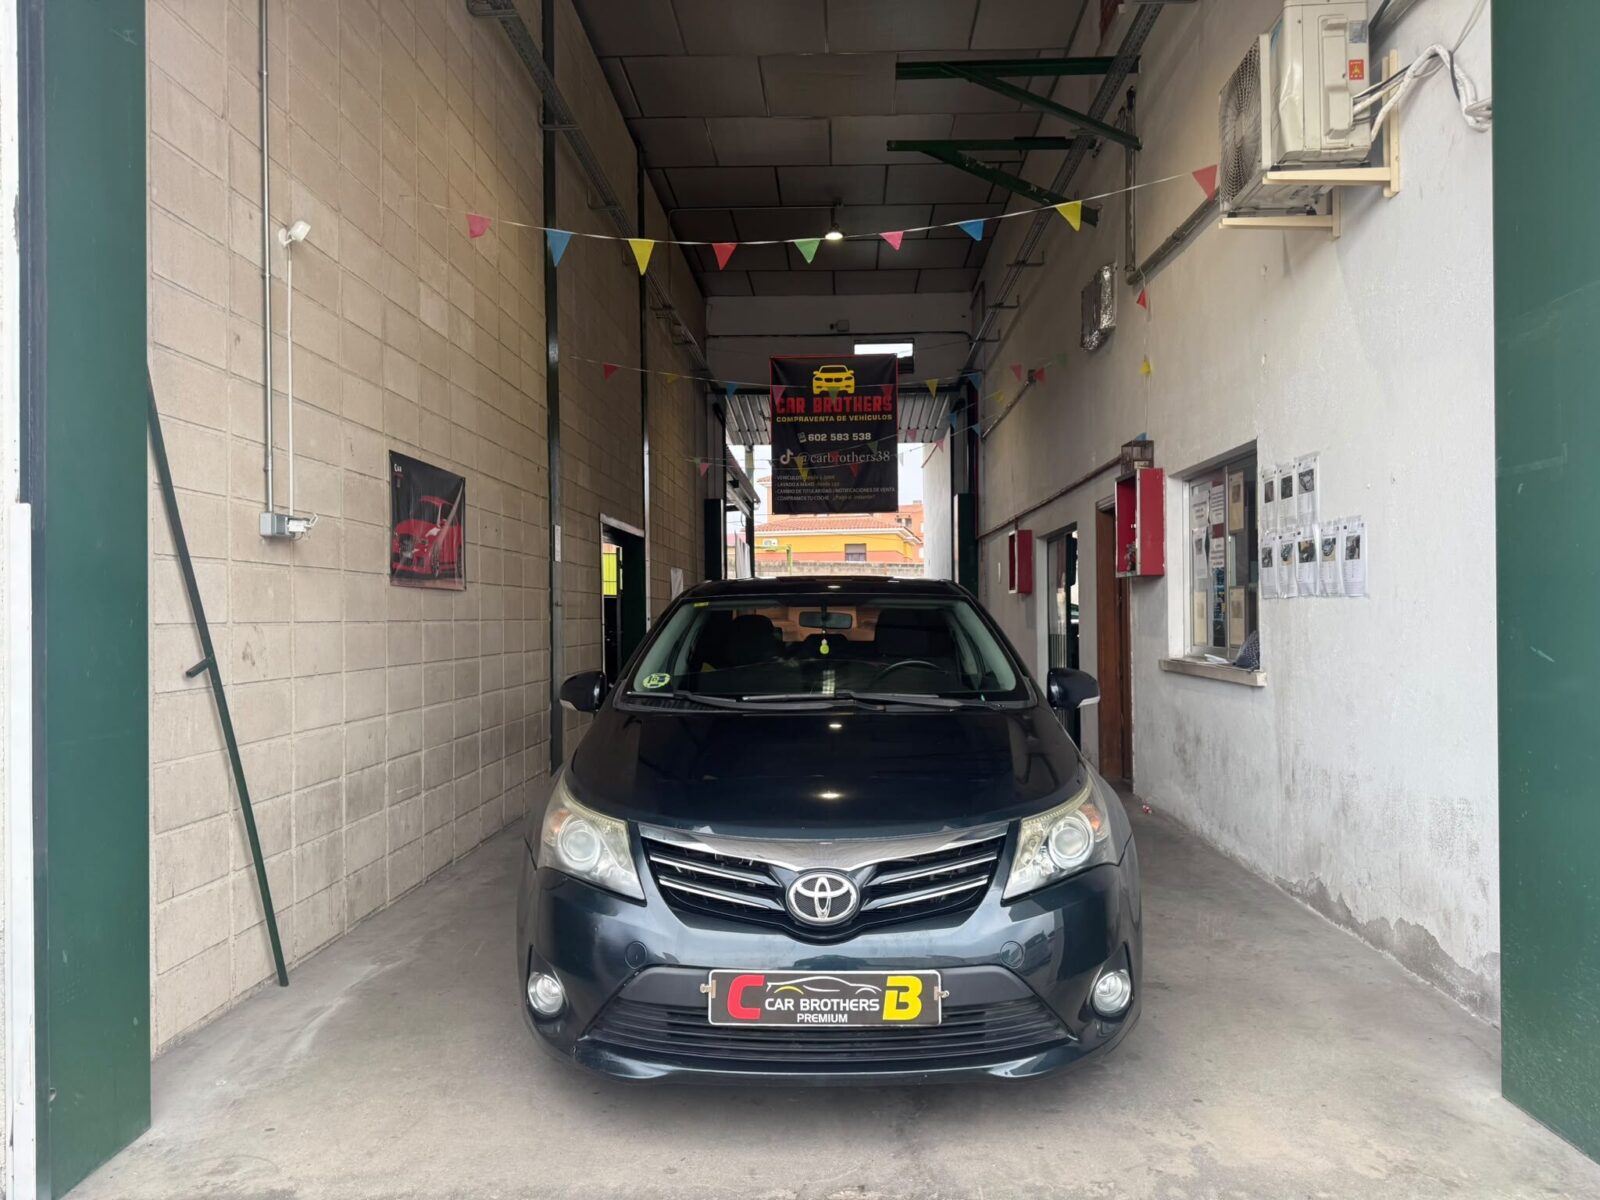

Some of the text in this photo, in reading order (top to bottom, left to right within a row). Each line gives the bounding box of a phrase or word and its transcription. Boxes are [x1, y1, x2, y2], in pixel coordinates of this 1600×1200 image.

[776, 395, 893, 414] CAR BROTHERS
[849, 414, 893, 422] VEHÍCULOS
[808, 432, 872, 442] 602 583 538
[727, 974, 765, 1020] C
[882, 975, 922, 1020] B
[765, 998, 880, 1011] CAR BROTHERS
[797, 1013, 848, 1023] PREMIUM
